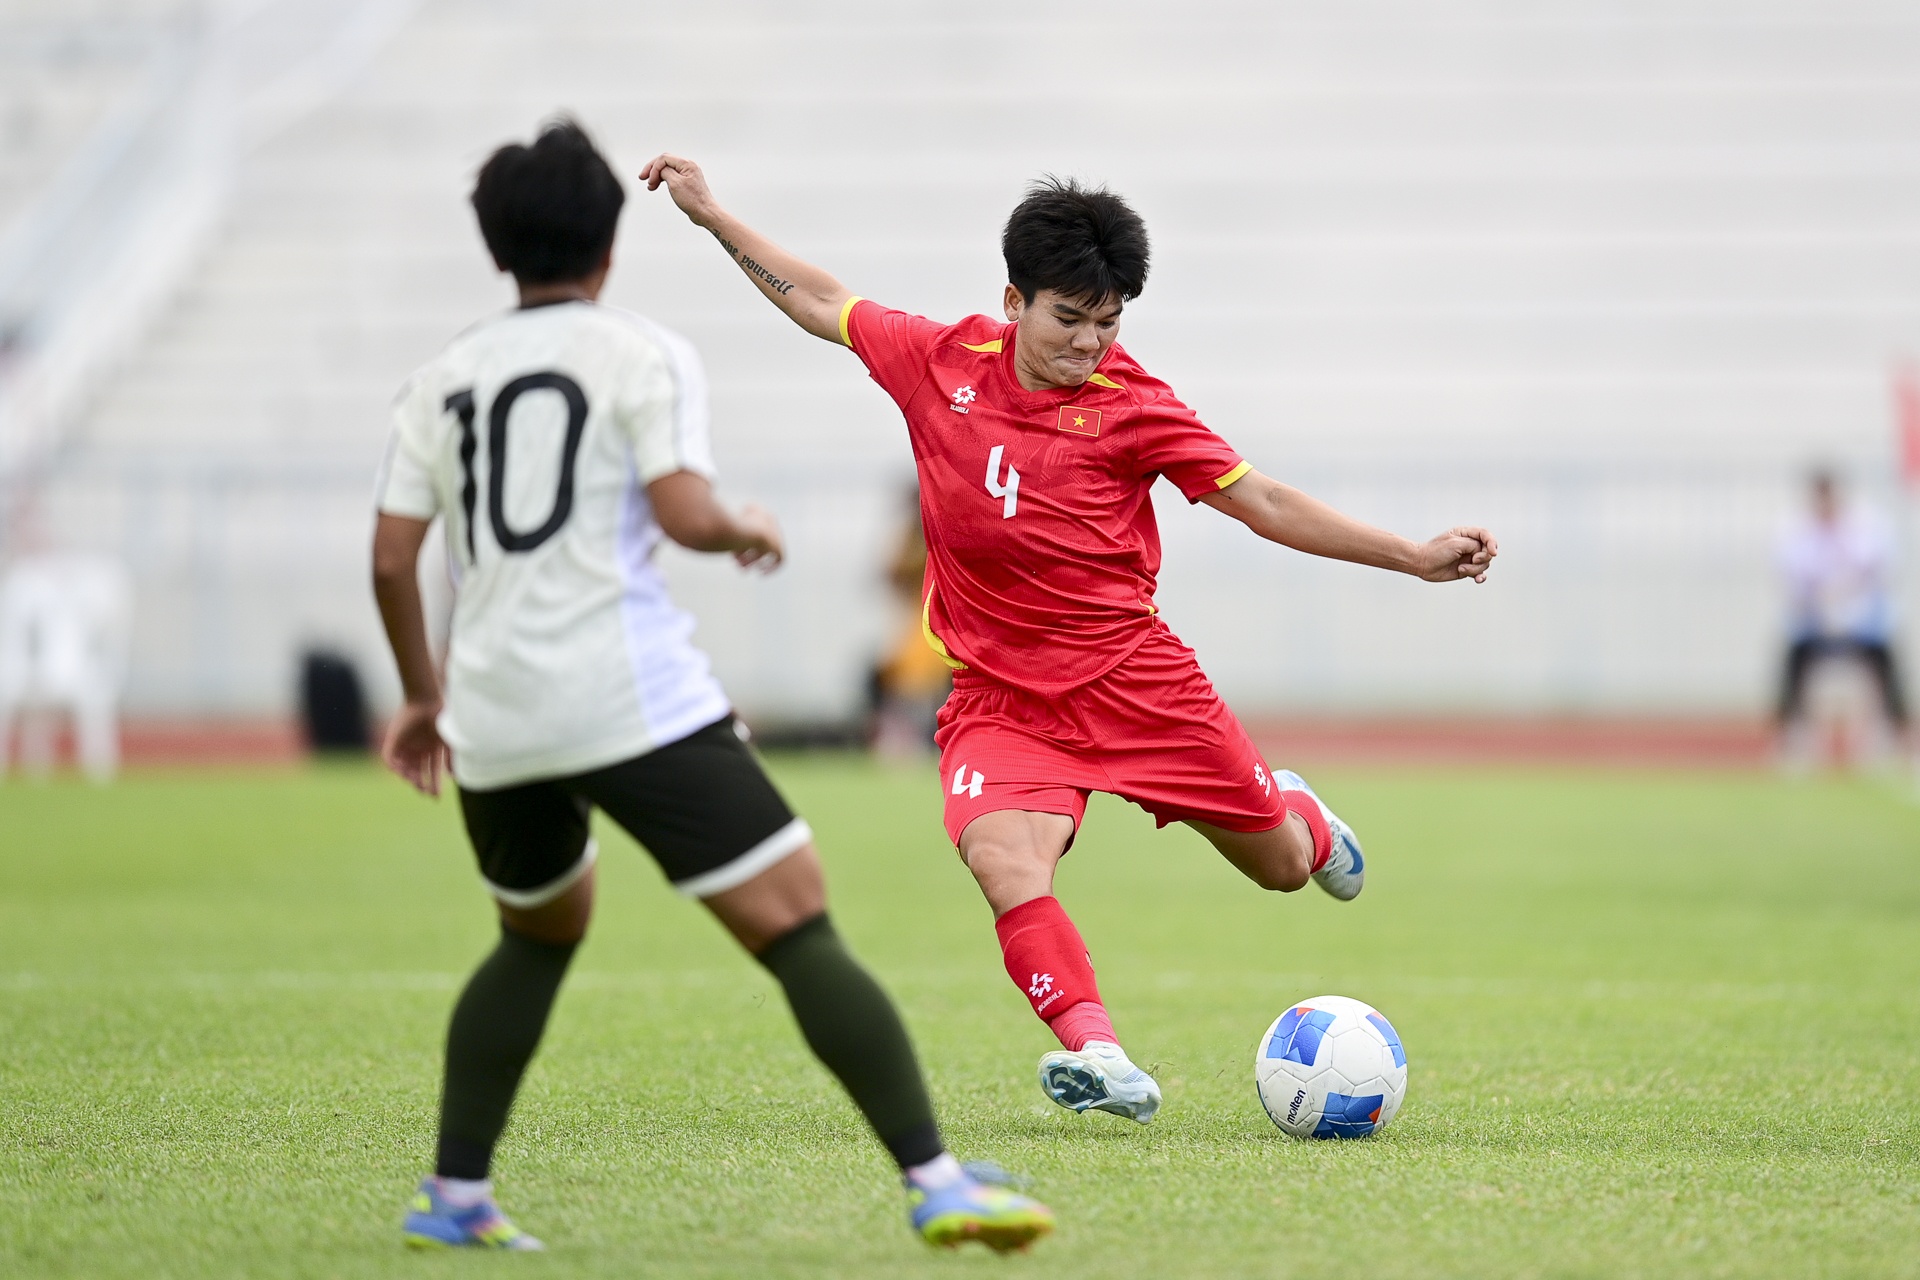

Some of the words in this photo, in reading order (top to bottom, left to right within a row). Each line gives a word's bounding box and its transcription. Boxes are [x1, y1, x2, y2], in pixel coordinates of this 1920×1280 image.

[741, 254, 795, 296] yourself
[444, 370, 589, 566] 10
[984, 444, 1021, 520] 4
[951, 763, 985, 800] 4
[1286, 1088, 1306, 1126] molten
